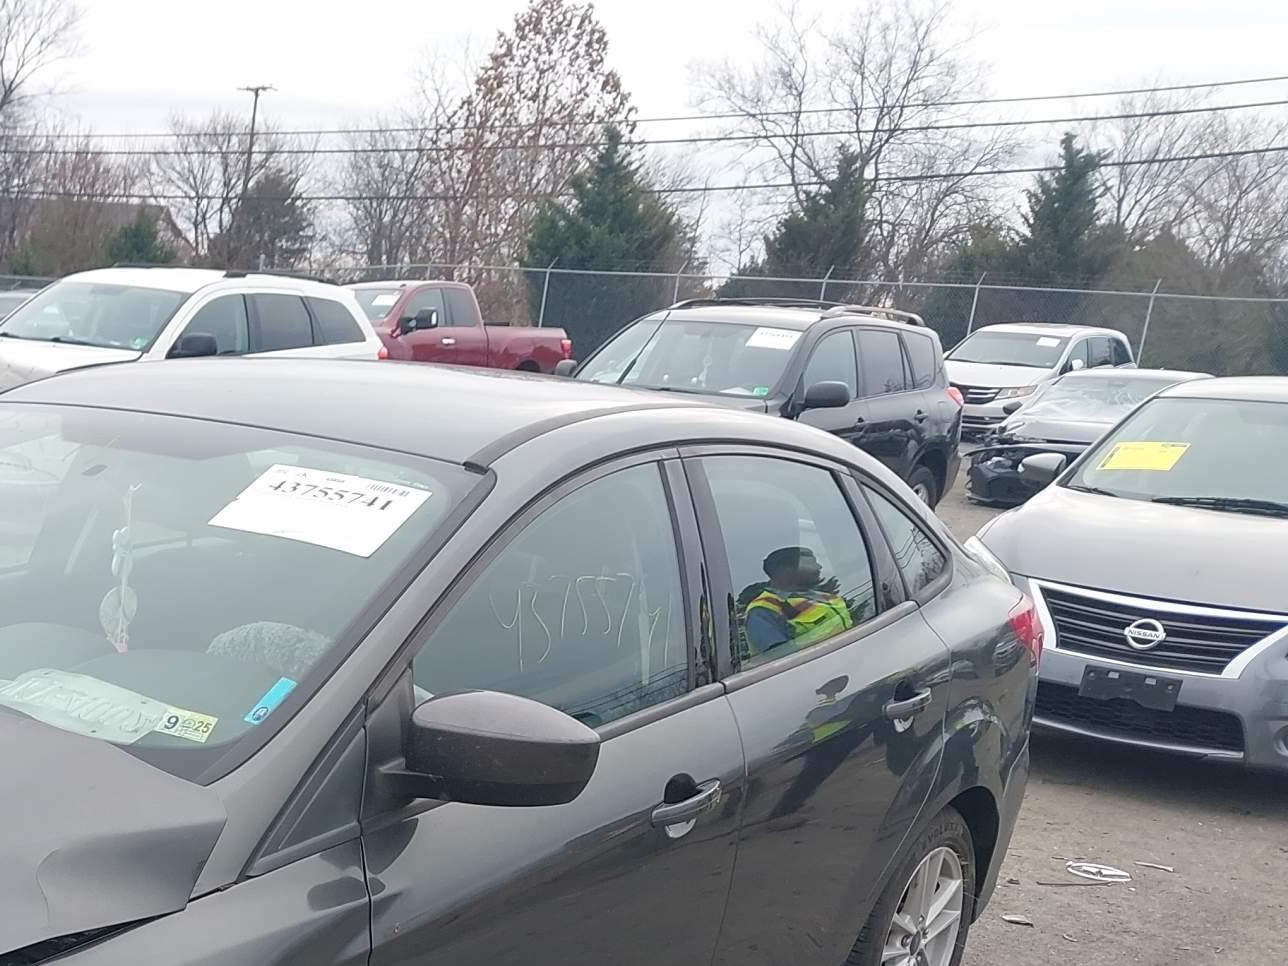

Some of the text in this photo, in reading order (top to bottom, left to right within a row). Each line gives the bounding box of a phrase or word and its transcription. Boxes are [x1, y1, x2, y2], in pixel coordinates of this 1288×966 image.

[268, 480, 393, 511] 43755741
[1127, 628, 1161, 639] NISSAN
[164, 715, 213, 734] 9 25
